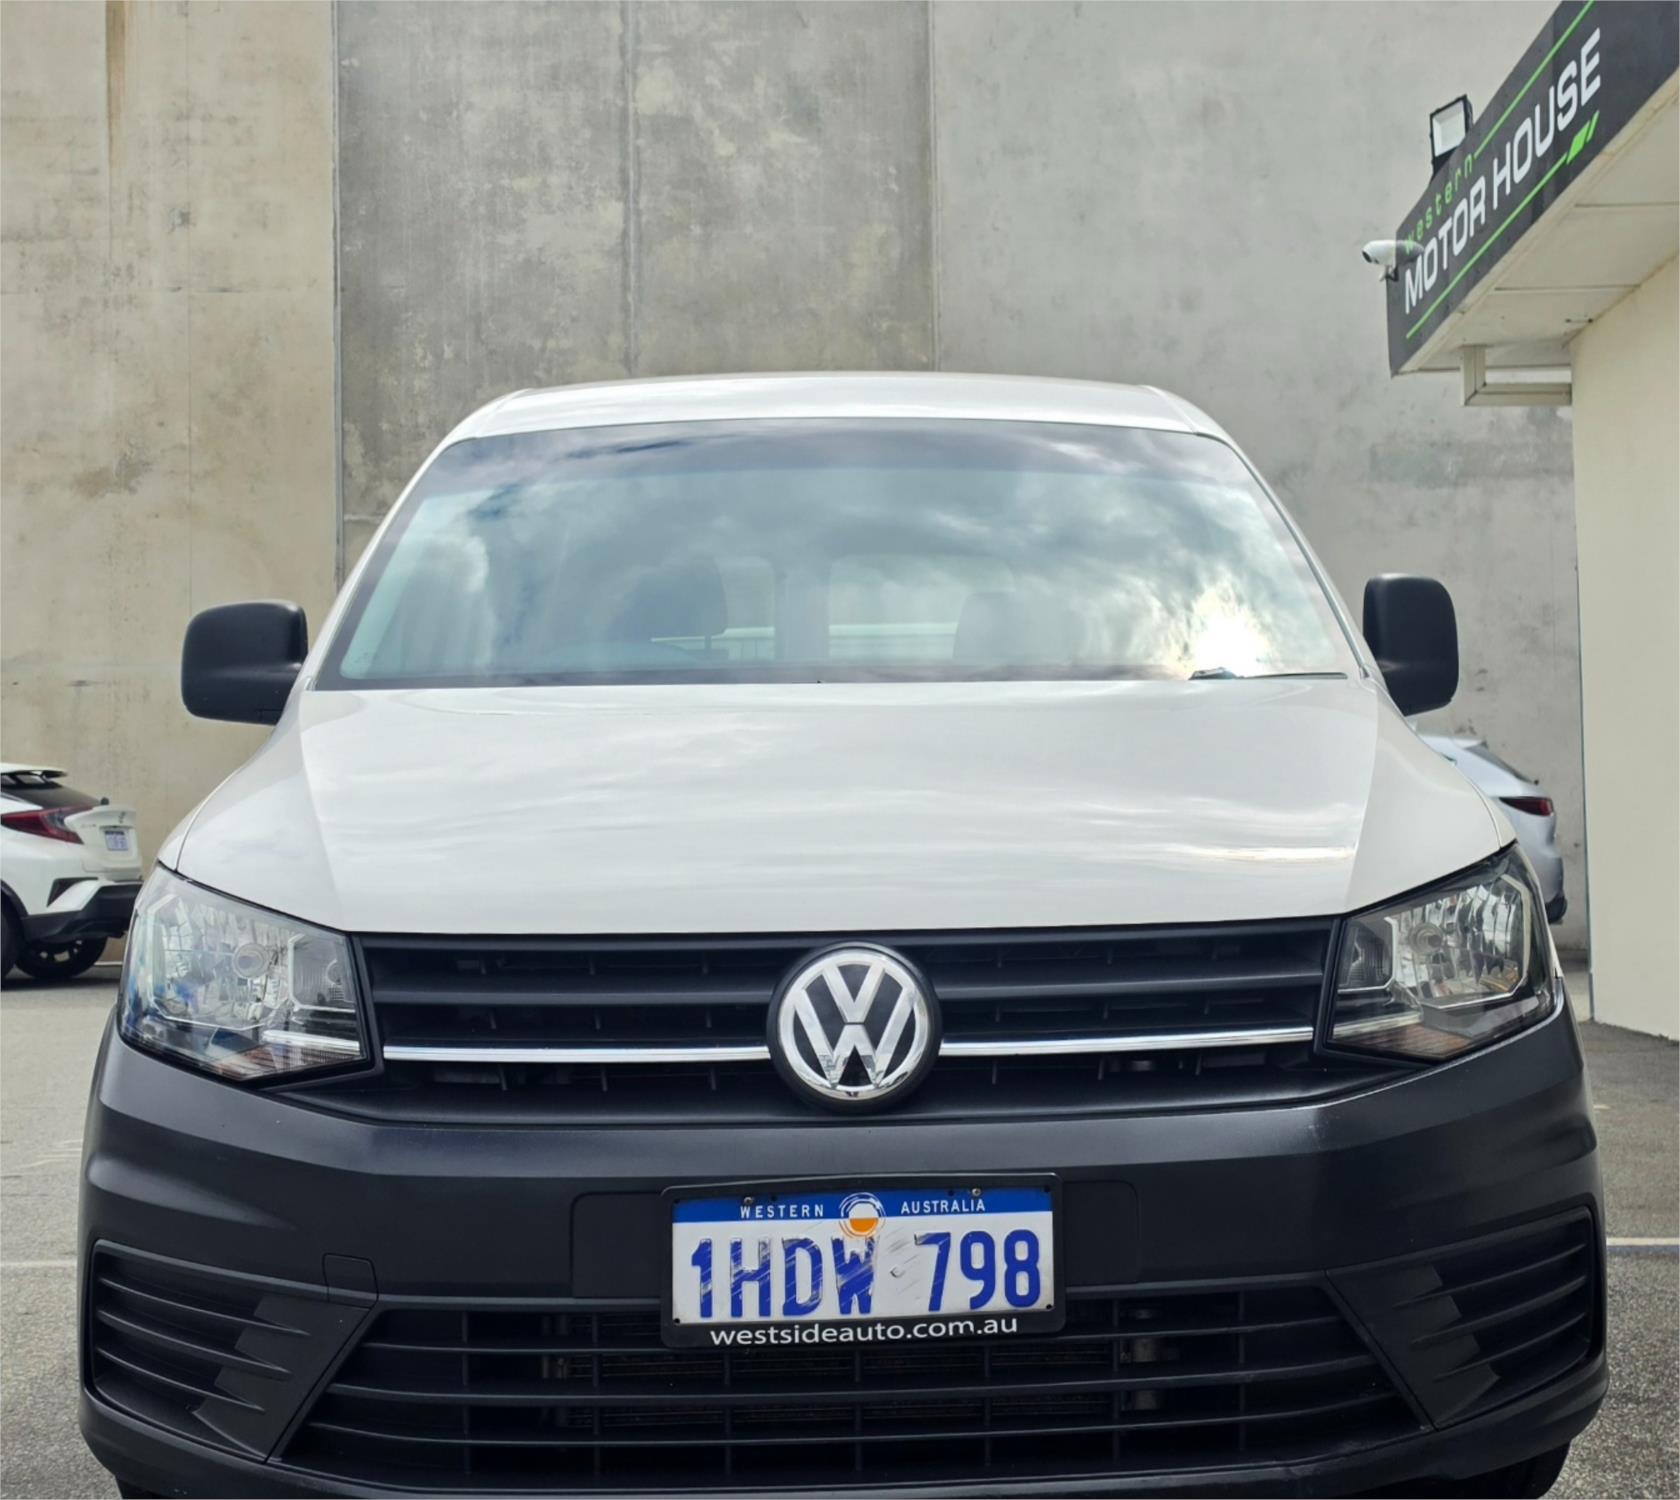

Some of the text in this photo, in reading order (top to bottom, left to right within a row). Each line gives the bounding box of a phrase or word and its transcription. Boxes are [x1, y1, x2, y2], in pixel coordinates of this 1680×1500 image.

[1404, 27, 1601, 315] MOTOR HOUSE
[740, 1198, 986, 1219] WESTERN AUSTRALIA
[691, 1228, 1041, 1318] 1HDW 798
[710, 1317, 1018, 1346] westsideauto.com.au
